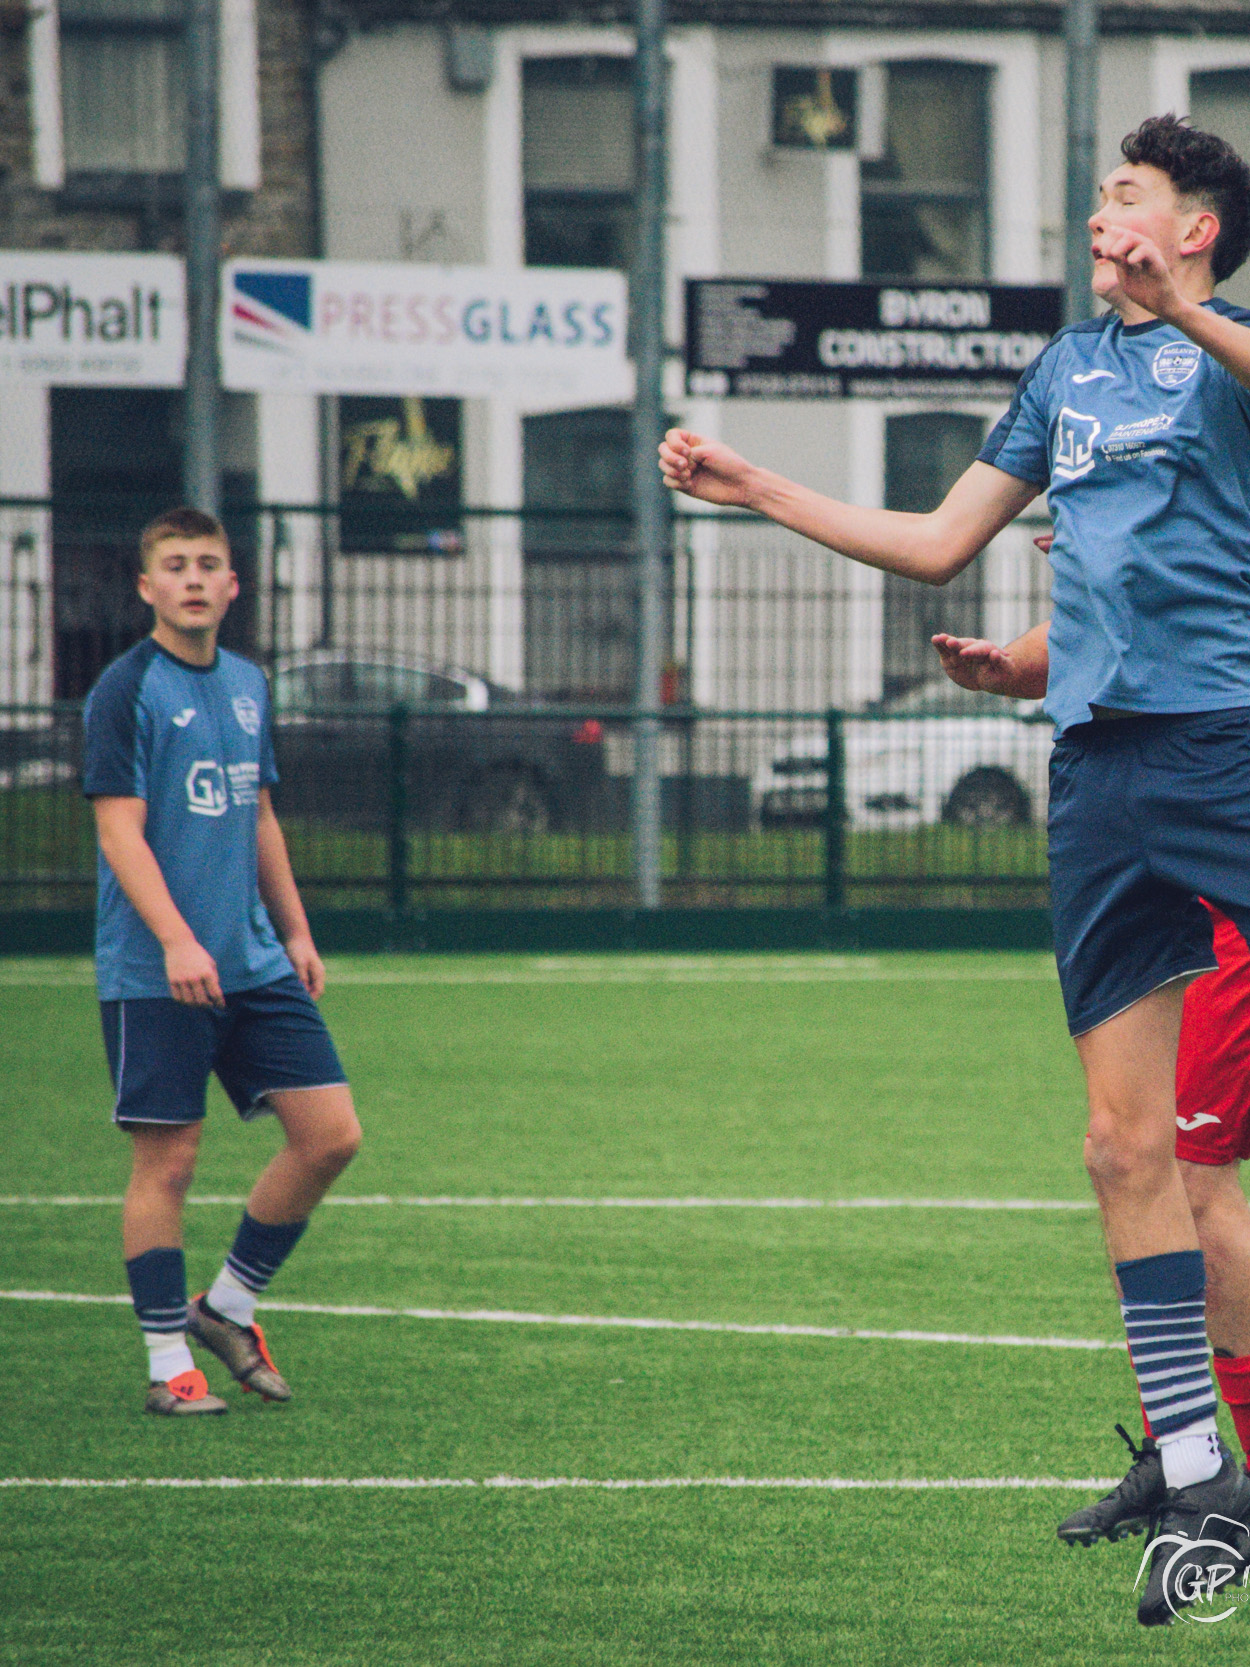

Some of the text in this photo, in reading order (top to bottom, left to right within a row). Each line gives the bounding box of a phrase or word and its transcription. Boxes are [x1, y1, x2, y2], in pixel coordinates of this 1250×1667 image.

[0, 282, 160, 341] lPhalt
[322, 293, 613, 347] PRESSGLASS
[879, 289, 990, 327] BYRON
